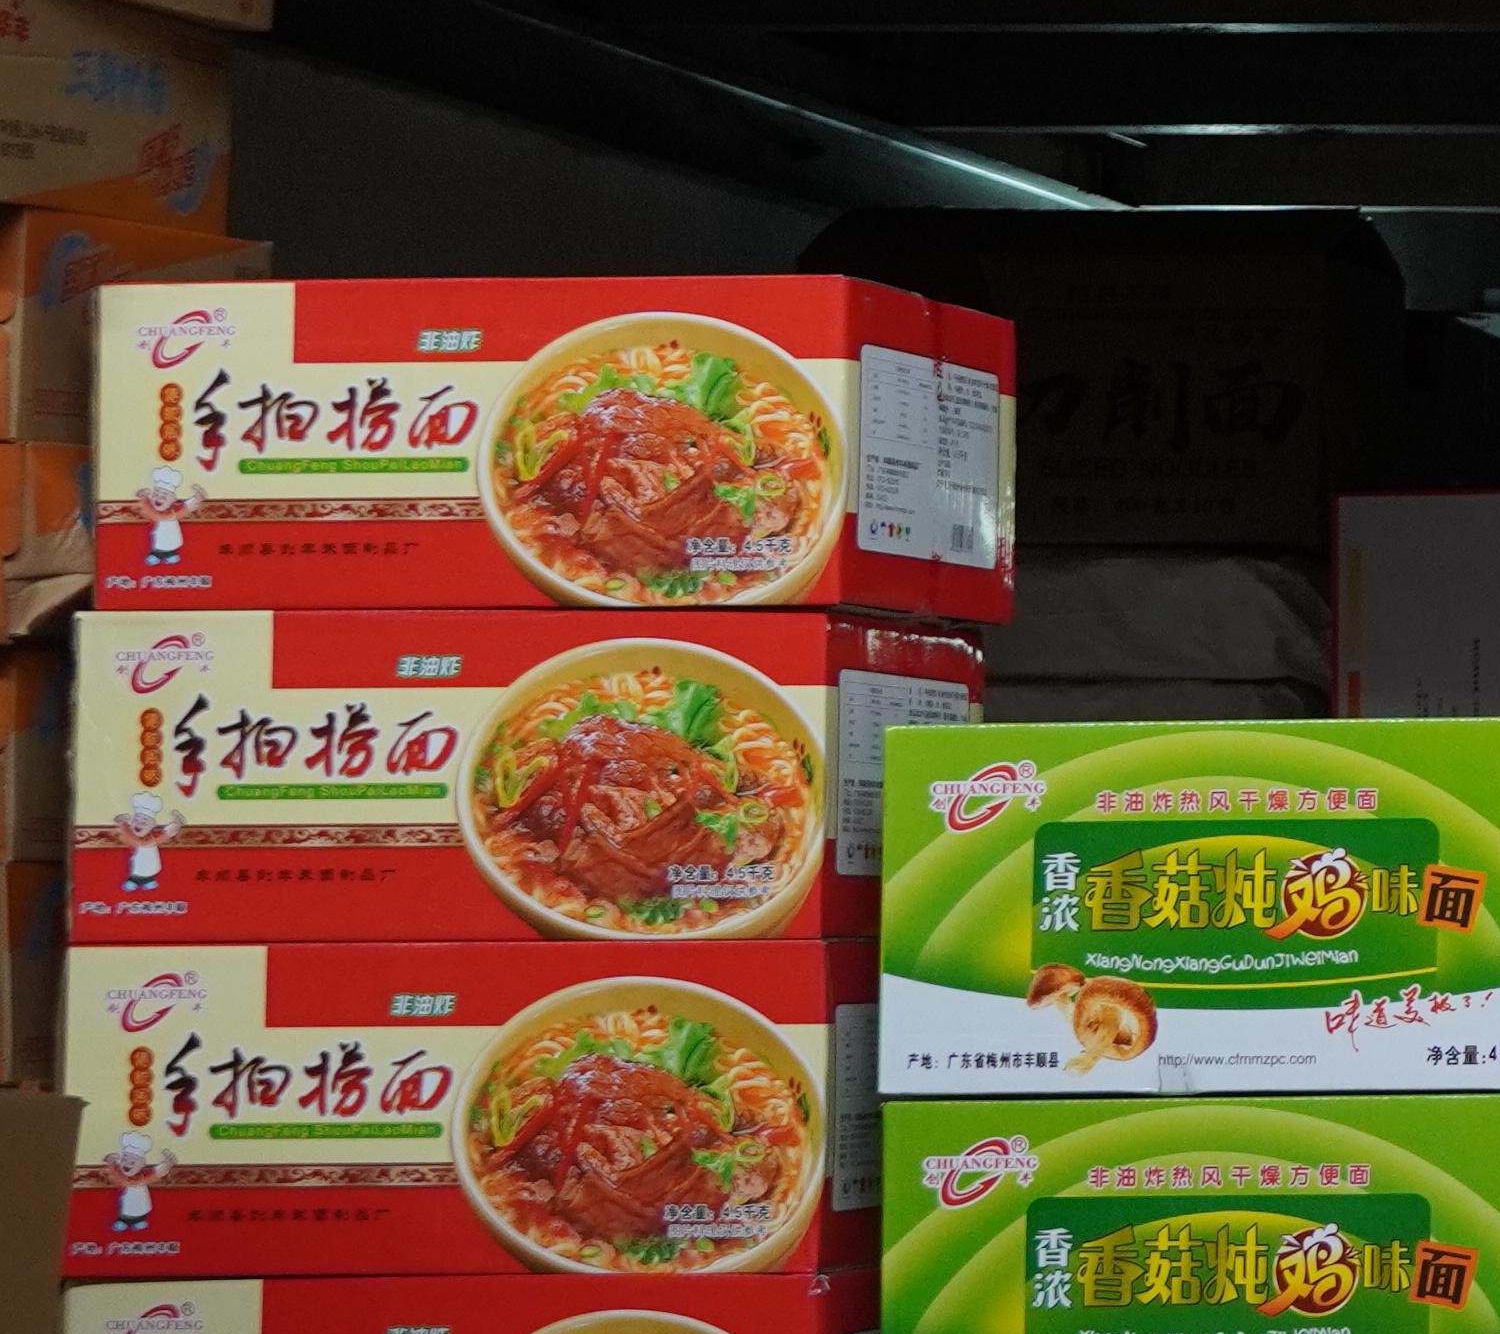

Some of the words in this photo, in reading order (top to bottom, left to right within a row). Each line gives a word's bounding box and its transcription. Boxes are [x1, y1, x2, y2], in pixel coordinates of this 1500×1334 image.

[138, 325, 237, 338] CHUANGFENG
[417, 329, 481, 353] 非油炸
[193, 369, 480, 472] 手拍捞面
[397, 655, 461, 678] 非油炸
[173, 695, 459, 798] 手拍捞面
[931, 781, 1046, 797] CHUANGFENG
[1097, 789, 1378, 814] 非油炸热风干燥方便面
[163, 1034, 452, 1137] 手拍捞面
